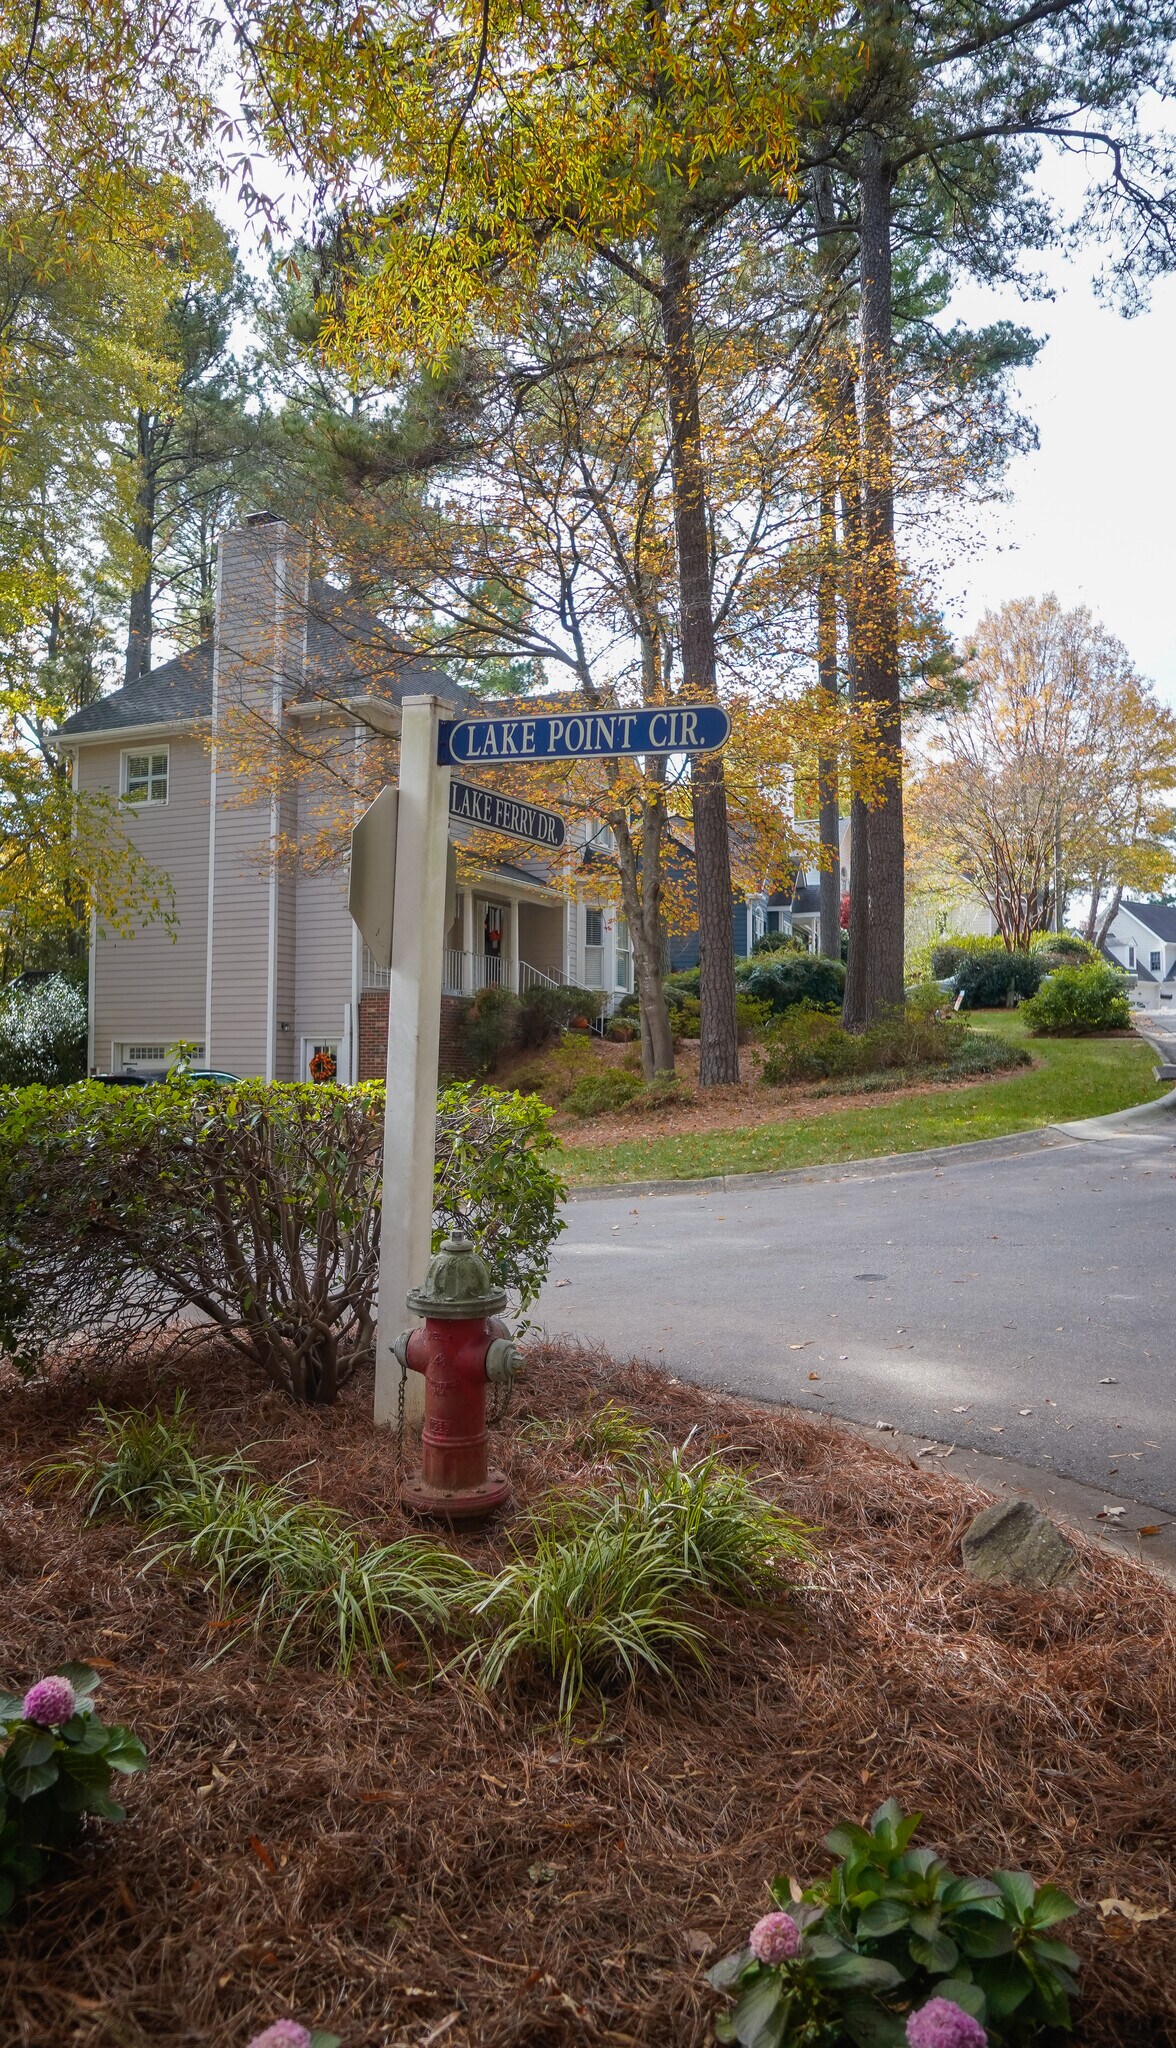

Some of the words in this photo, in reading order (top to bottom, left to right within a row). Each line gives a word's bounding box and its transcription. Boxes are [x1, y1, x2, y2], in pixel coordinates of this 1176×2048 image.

[466, 721, 537, 757] LAKE
[547, 715, 638, 752] POINT
[649, 711, 705, 748] CIR.
[451, 783, 493, 823] LAKE
[494, 798, 537, 837] FERRY
[537, 813, 558, 844] DR.
